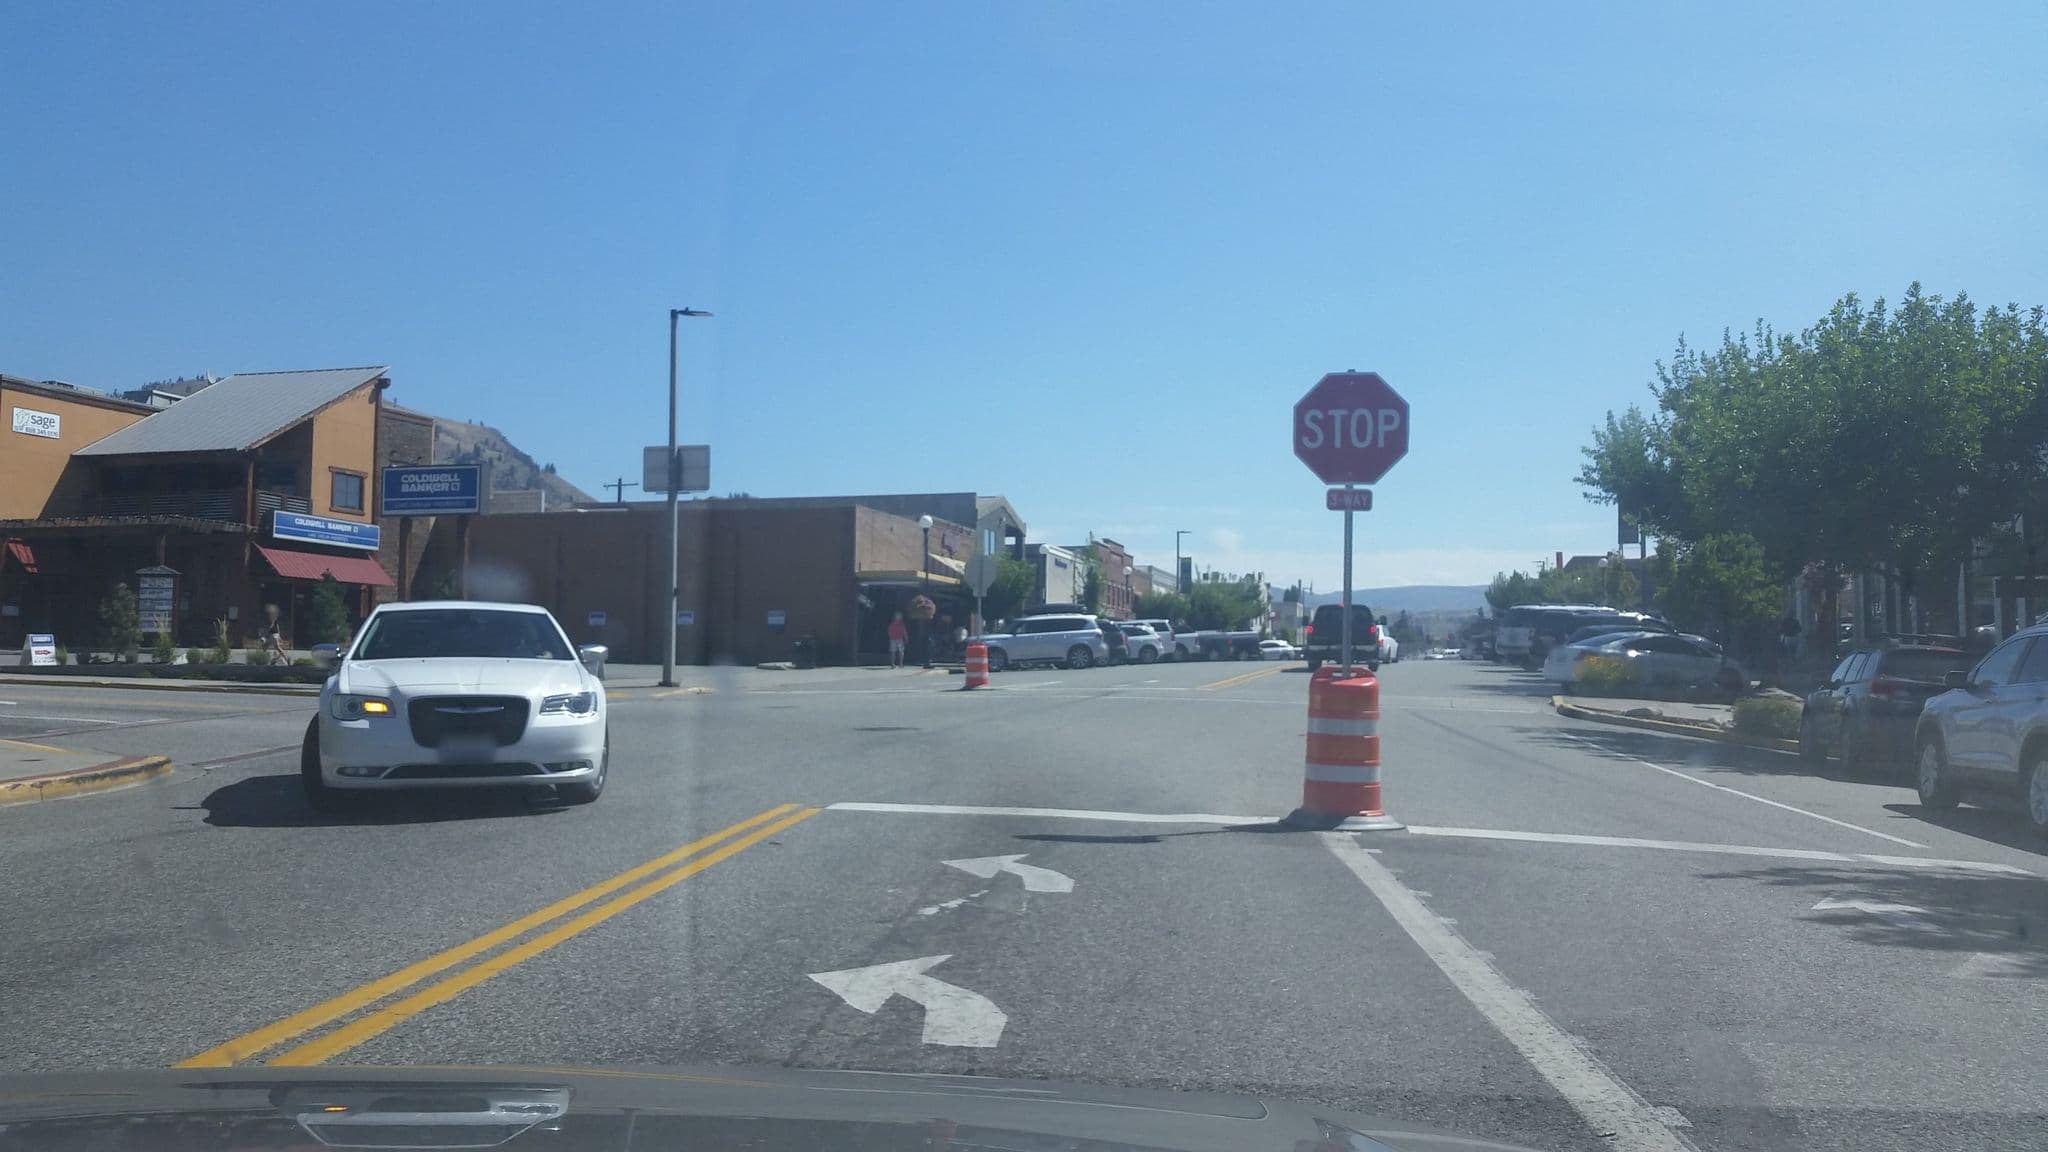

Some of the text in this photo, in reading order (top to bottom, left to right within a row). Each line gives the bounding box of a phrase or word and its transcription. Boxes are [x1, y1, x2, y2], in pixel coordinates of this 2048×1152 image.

[30, 415, 55, 429] sage
[1302, 408, 1401, 448] STOP
[1329, 494, 1369, 507] 3-WAY
